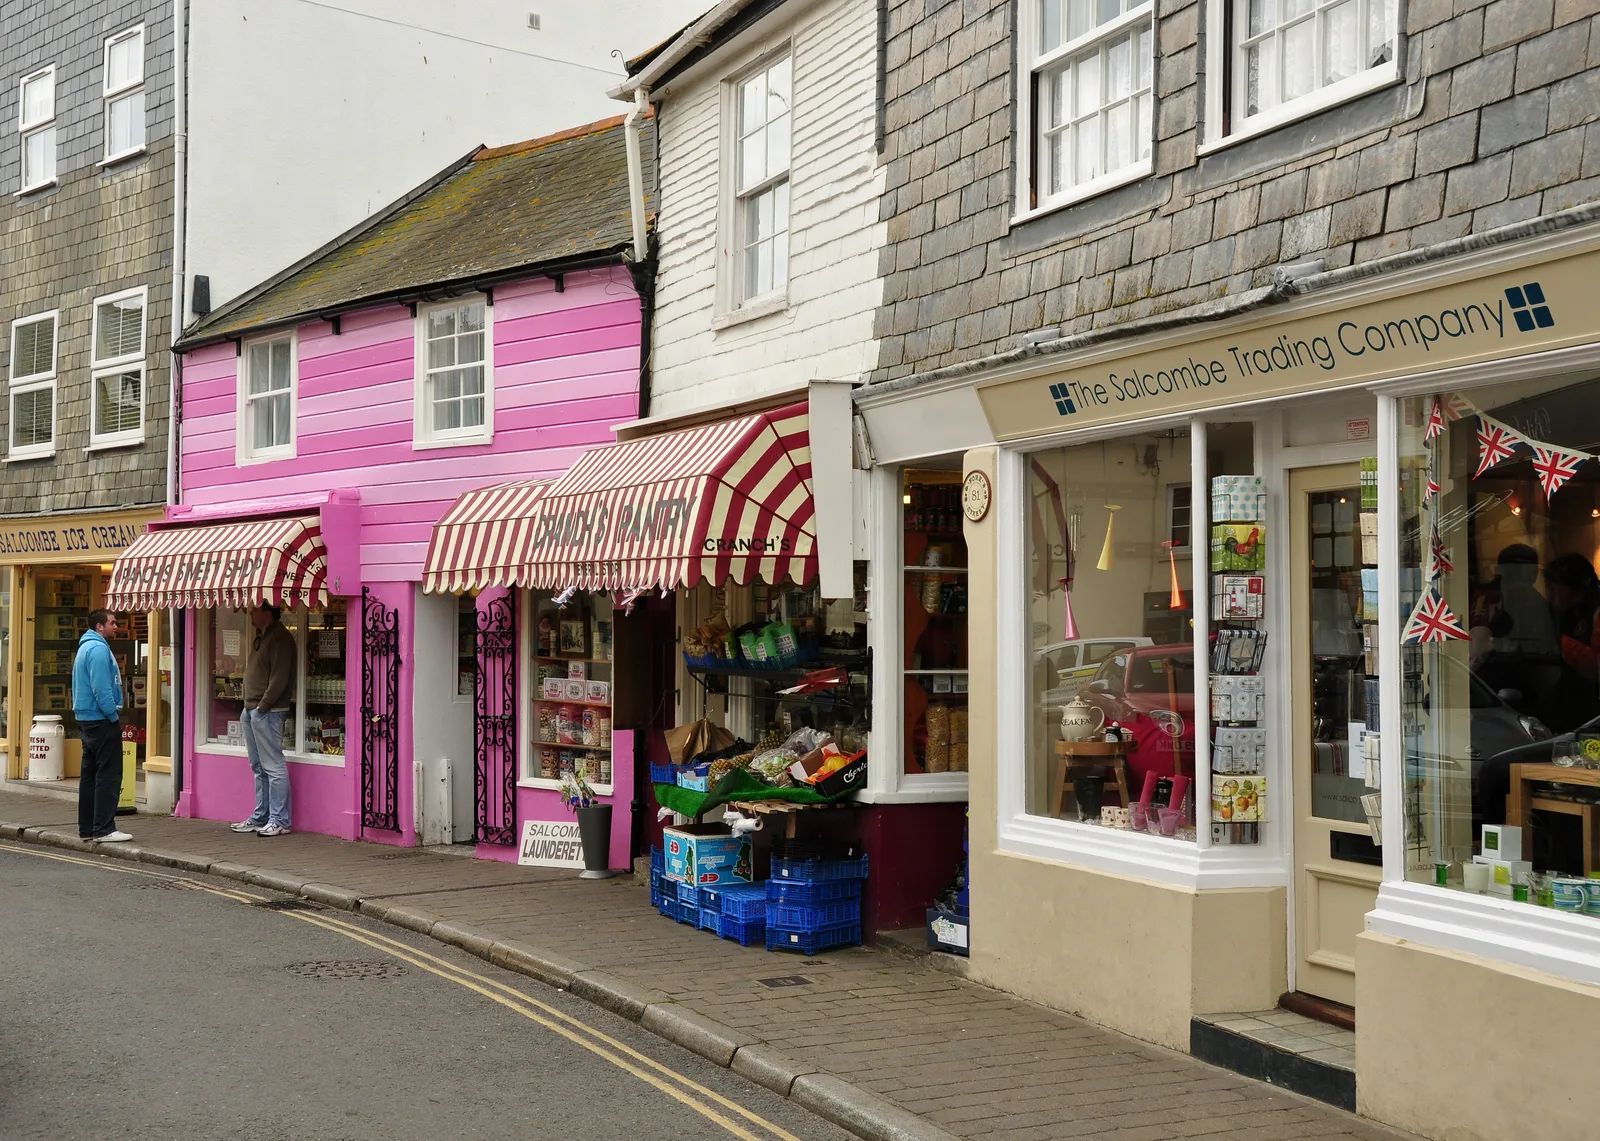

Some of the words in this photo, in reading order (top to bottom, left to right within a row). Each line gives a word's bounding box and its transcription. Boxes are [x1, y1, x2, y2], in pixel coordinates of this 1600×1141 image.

[1068, 380, 1109, 409] The
[1109, 357, 1228, 402] Salcombe
[1227, 334, 1336, 377] Trading
[1337, 299, 1503, 357] Company
[971, 490, 981, 501] 81
[617, 496, 698, 544] PANTRY
[0, 530, 61, 553] SALCOMBE
[62, 527, 90, 550] ICE
[91, 524, 138, 548] CREAM
[703, 535, 790, 552] CRANCH'S
[178, 560, 222, 582] SWEET
[225, 557, 262, 579] SHOP
[30, 736, 46, 744] RESH
[528, 823, 581, 839] SALCOM
[522, 839, 585, 862] LAUNDERET
